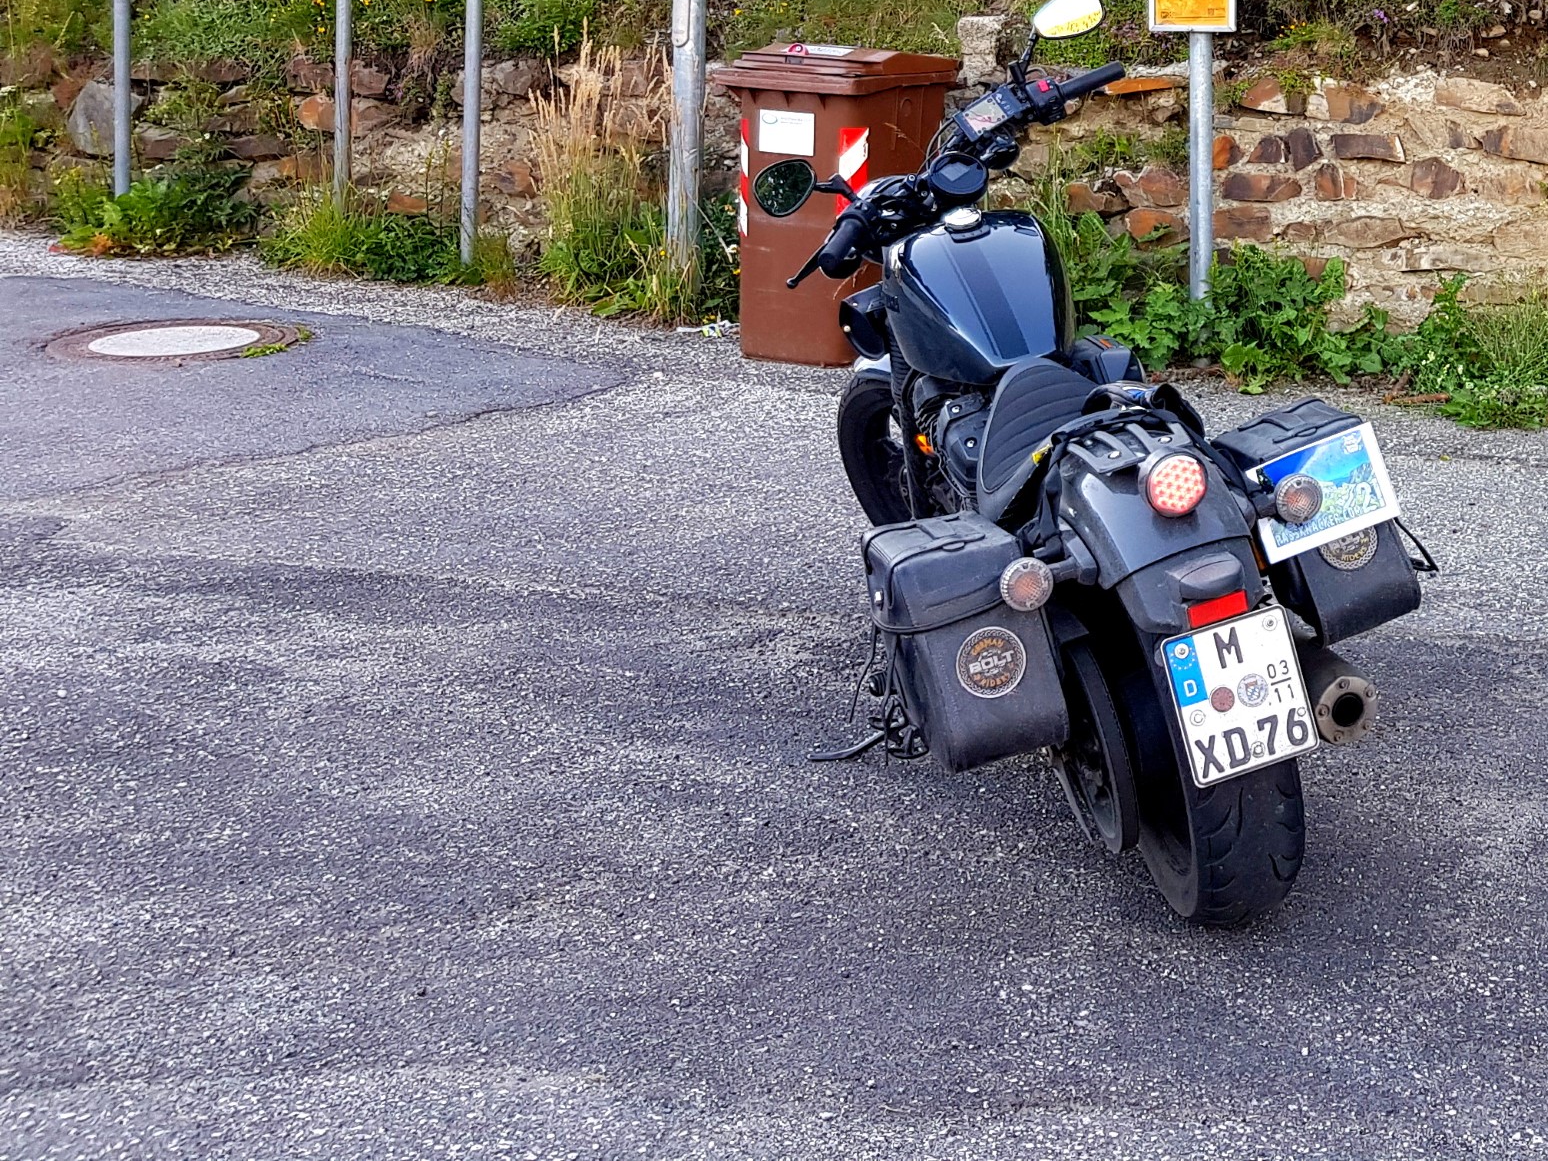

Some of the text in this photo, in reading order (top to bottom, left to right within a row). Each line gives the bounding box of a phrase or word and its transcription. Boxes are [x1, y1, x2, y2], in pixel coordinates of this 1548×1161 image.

[1213, 626, 1244, 669] M
[968, 649, 1015, 675] BOLT
[1266, 659, 1290, 679] 03
[1183, 679, 1198, 698] D
[1274, 684, 1295, 703] 11
[1194, 707, 1310, 779] XD 76
